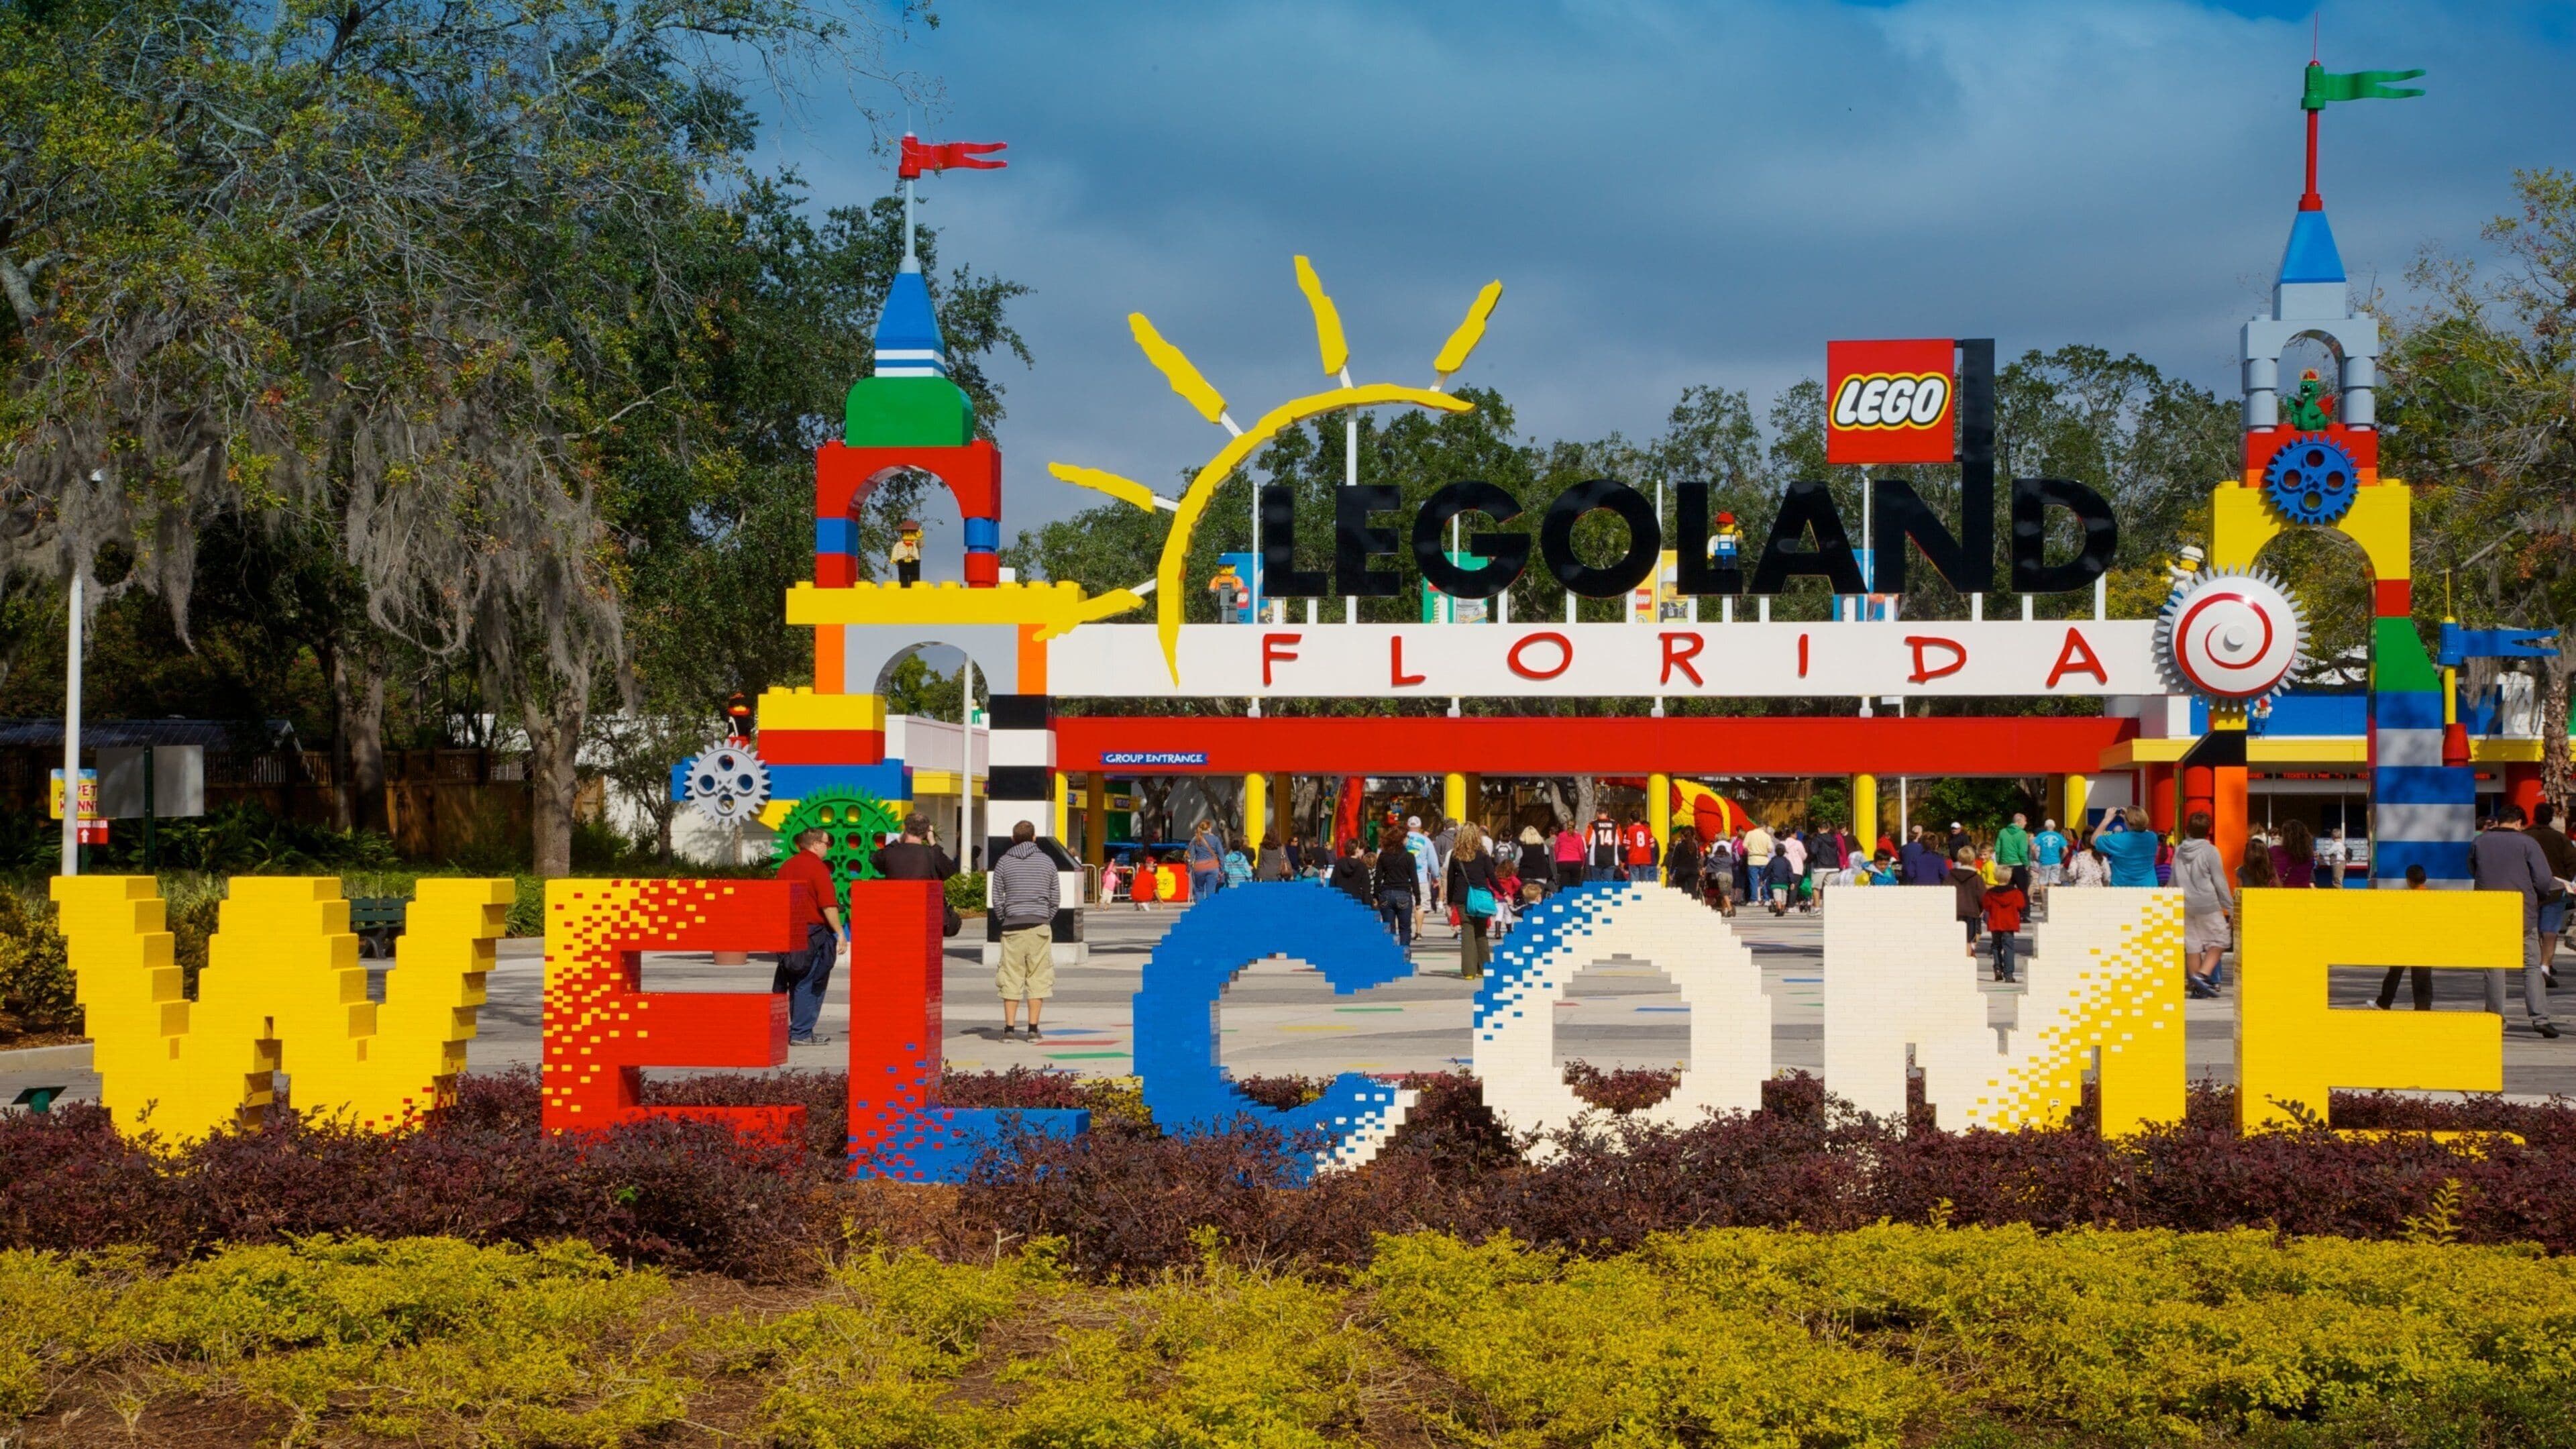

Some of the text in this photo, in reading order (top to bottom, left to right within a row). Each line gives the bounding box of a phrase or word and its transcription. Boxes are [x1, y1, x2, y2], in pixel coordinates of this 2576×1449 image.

[1835, 378, 1945, 425] LEGO
[1263, 627, 2107, 688] FLORIDA
[1106, 753, 1203, 764] GROUP ENTRANCE
[1598, 830, 1613, 845] 14
[1637, 831, 1645, 847] 8
[50, 875, 2525, 1186] WELCOME
